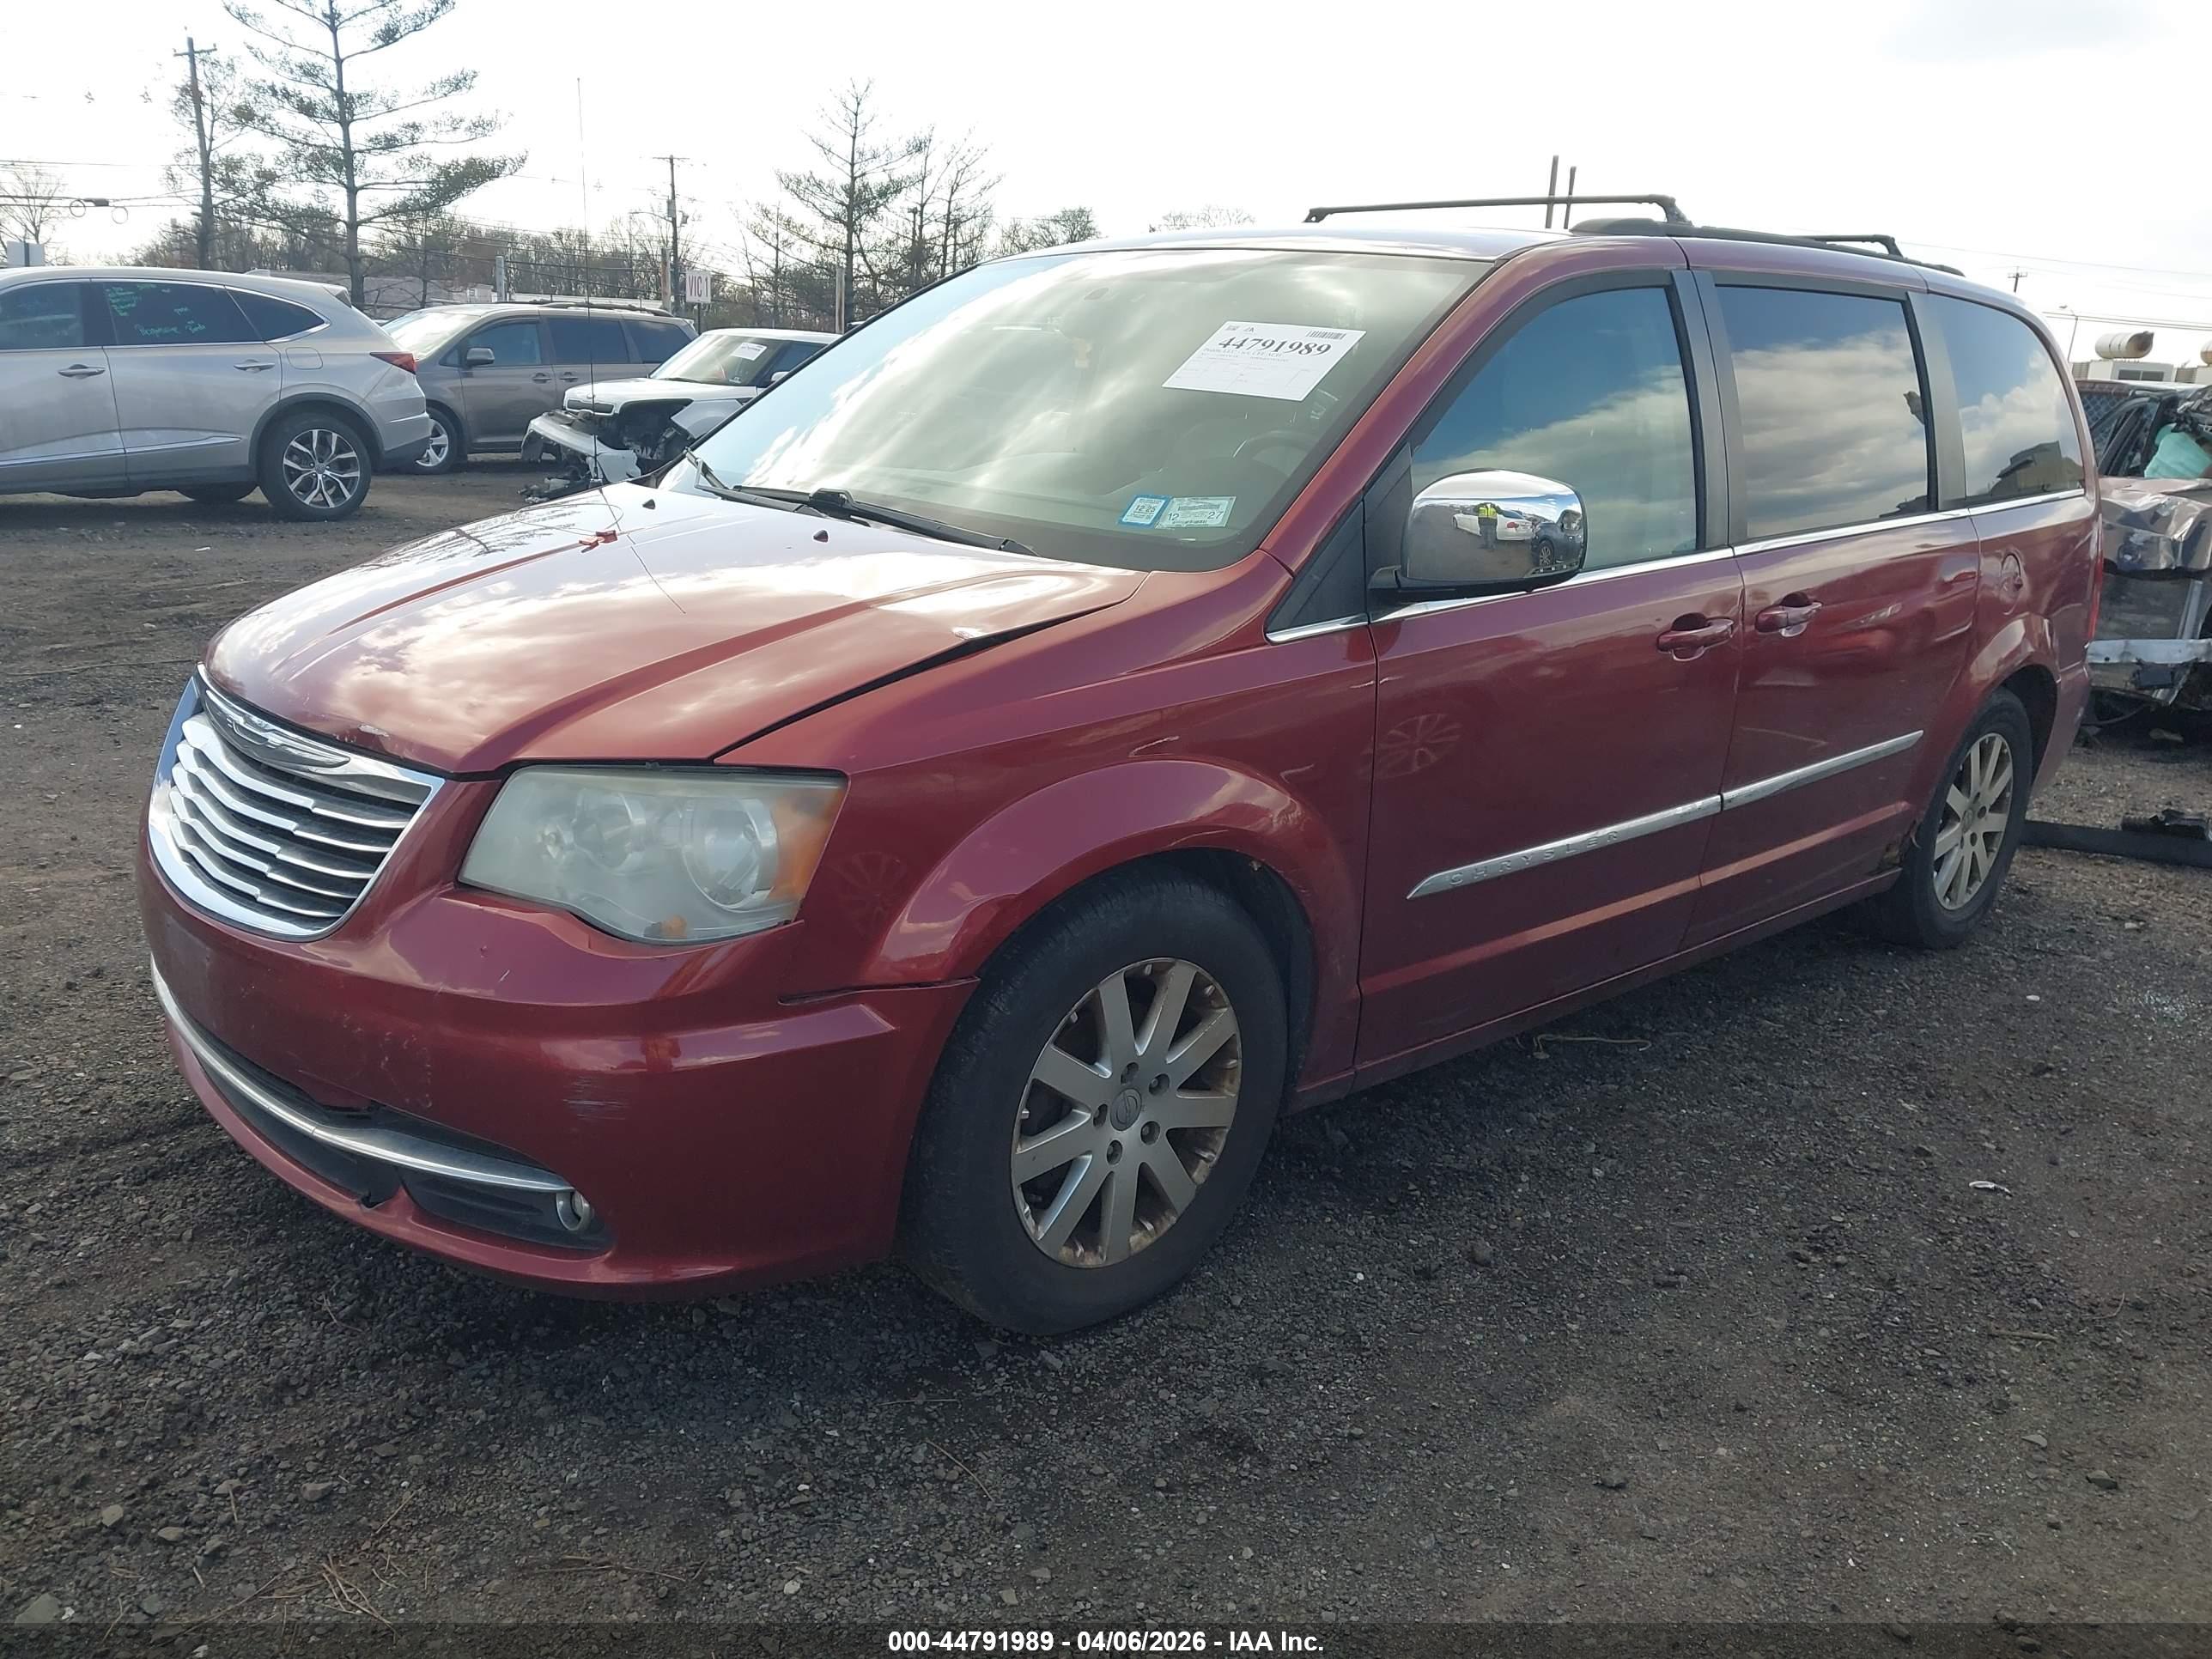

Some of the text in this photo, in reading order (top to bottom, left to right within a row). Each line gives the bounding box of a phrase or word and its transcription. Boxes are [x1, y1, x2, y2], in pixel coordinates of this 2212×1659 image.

[688, 274, 708, 298] VIC 1
[1218, 336, 1332, 356] 44791989
[1168, 511, 1224, 521] 12 27
[1449, 830, 1619, 886] CHRYSLER
